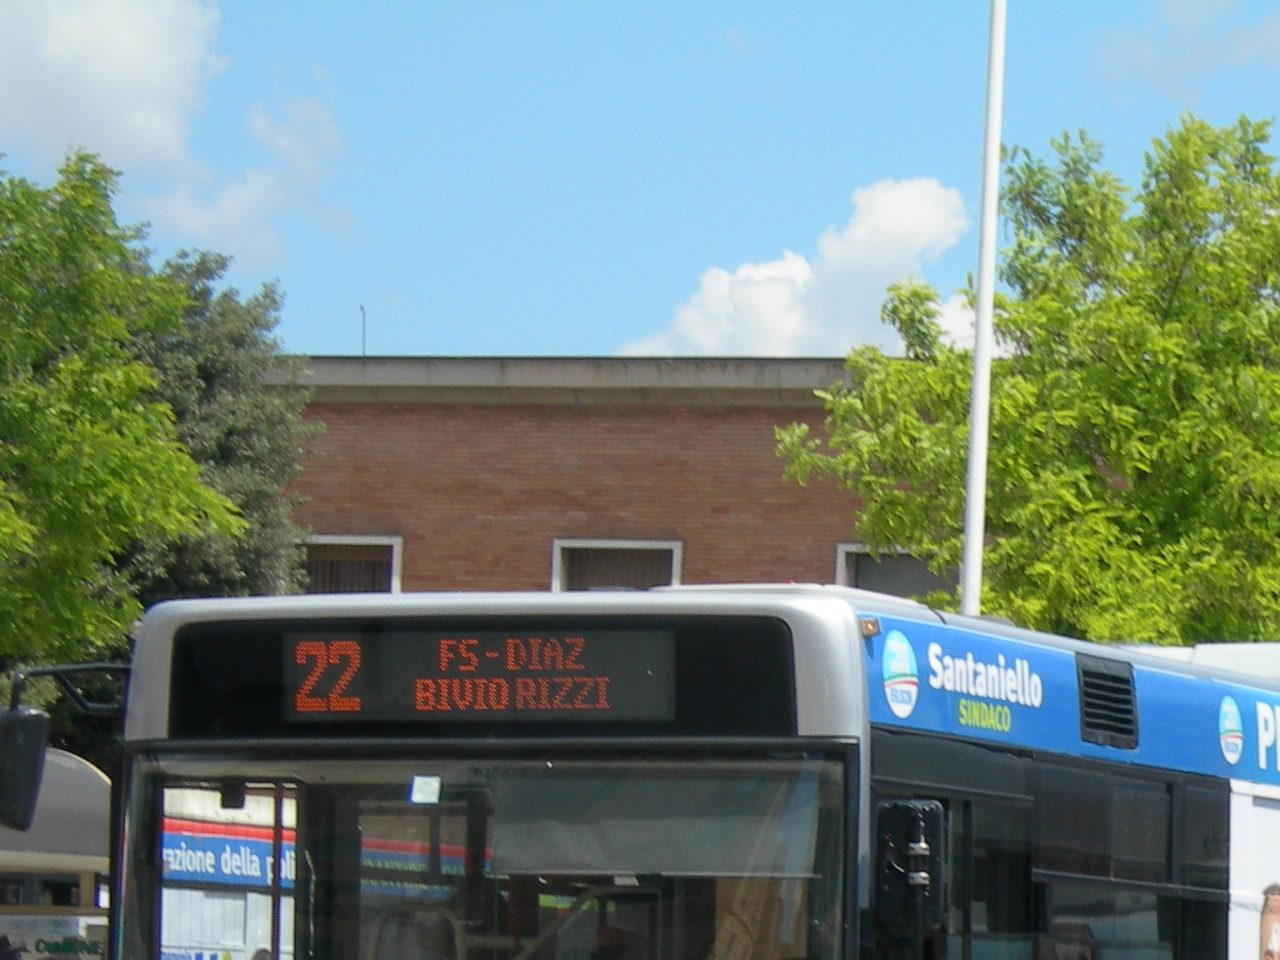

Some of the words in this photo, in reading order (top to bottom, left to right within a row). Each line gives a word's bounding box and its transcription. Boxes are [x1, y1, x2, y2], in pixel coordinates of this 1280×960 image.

[294, 640, 362, 712] 22
[927, 641, 1043, 709] Santaniello
[414, 678, 509, 712] BIVIO
[515, 677, 610, 711] RIZZI
[957, 699, 1012, 733] SINDACO
[221, 844, 261, 878] della
